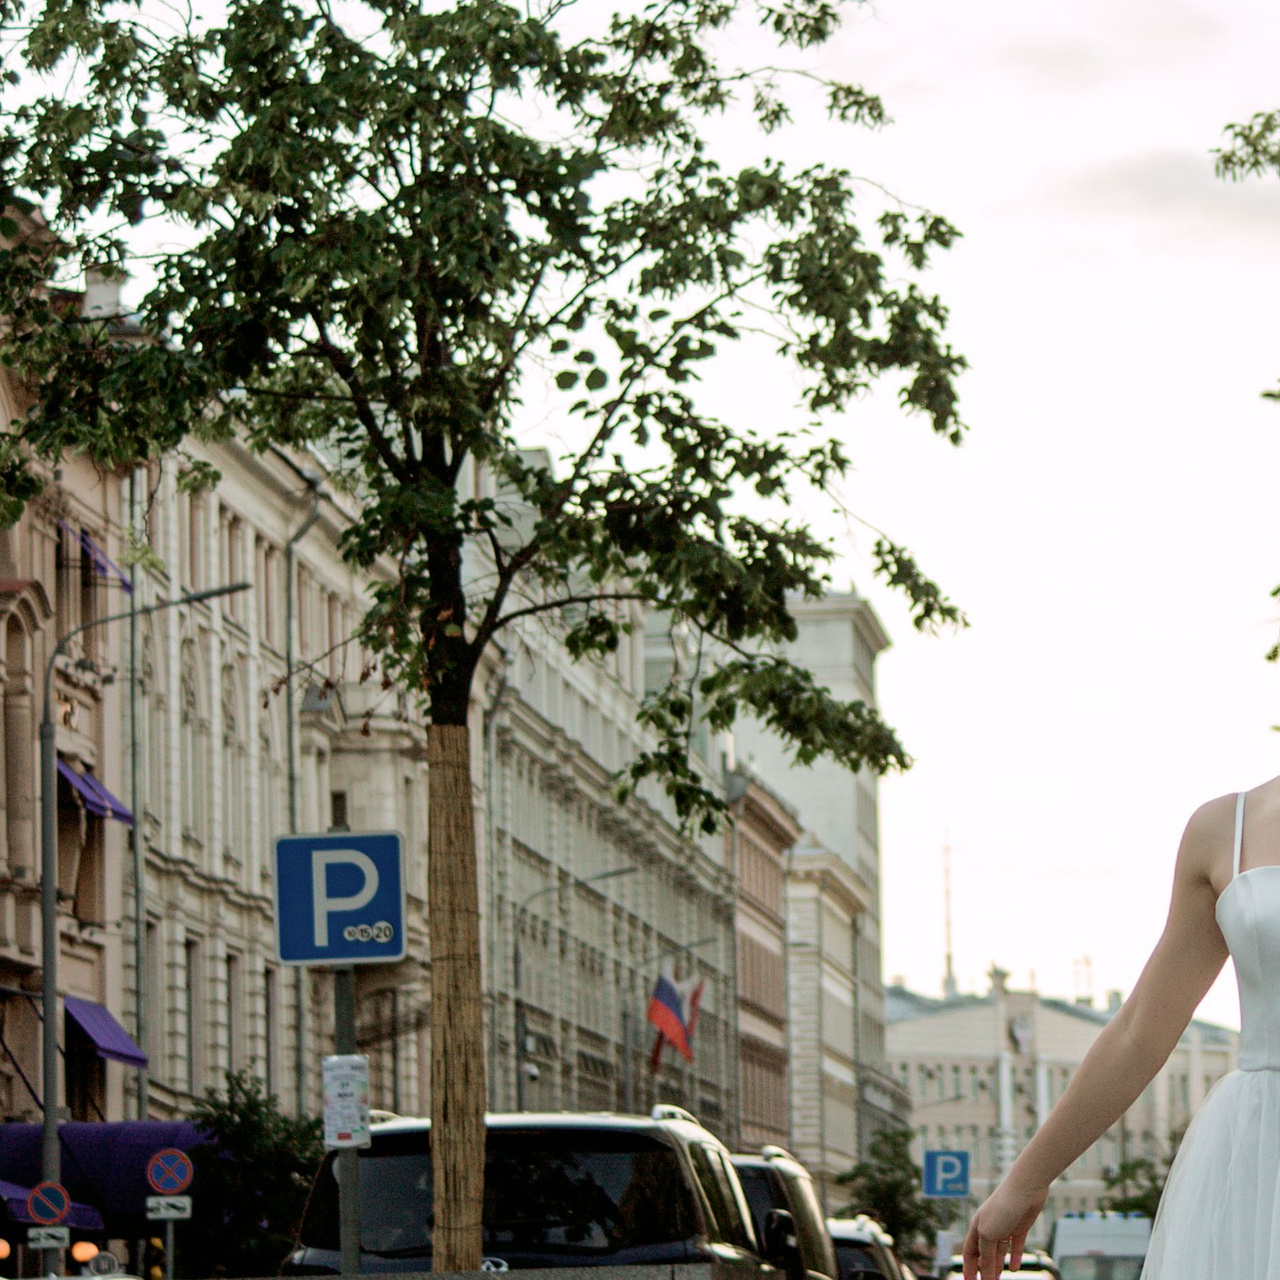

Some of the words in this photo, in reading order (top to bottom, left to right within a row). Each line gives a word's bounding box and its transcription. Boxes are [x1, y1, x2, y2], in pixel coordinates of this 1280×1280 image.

[311, 849, 379, 948] P
[375, 926, 392, 939] 20
[936, 1155, 961, 1191] P
